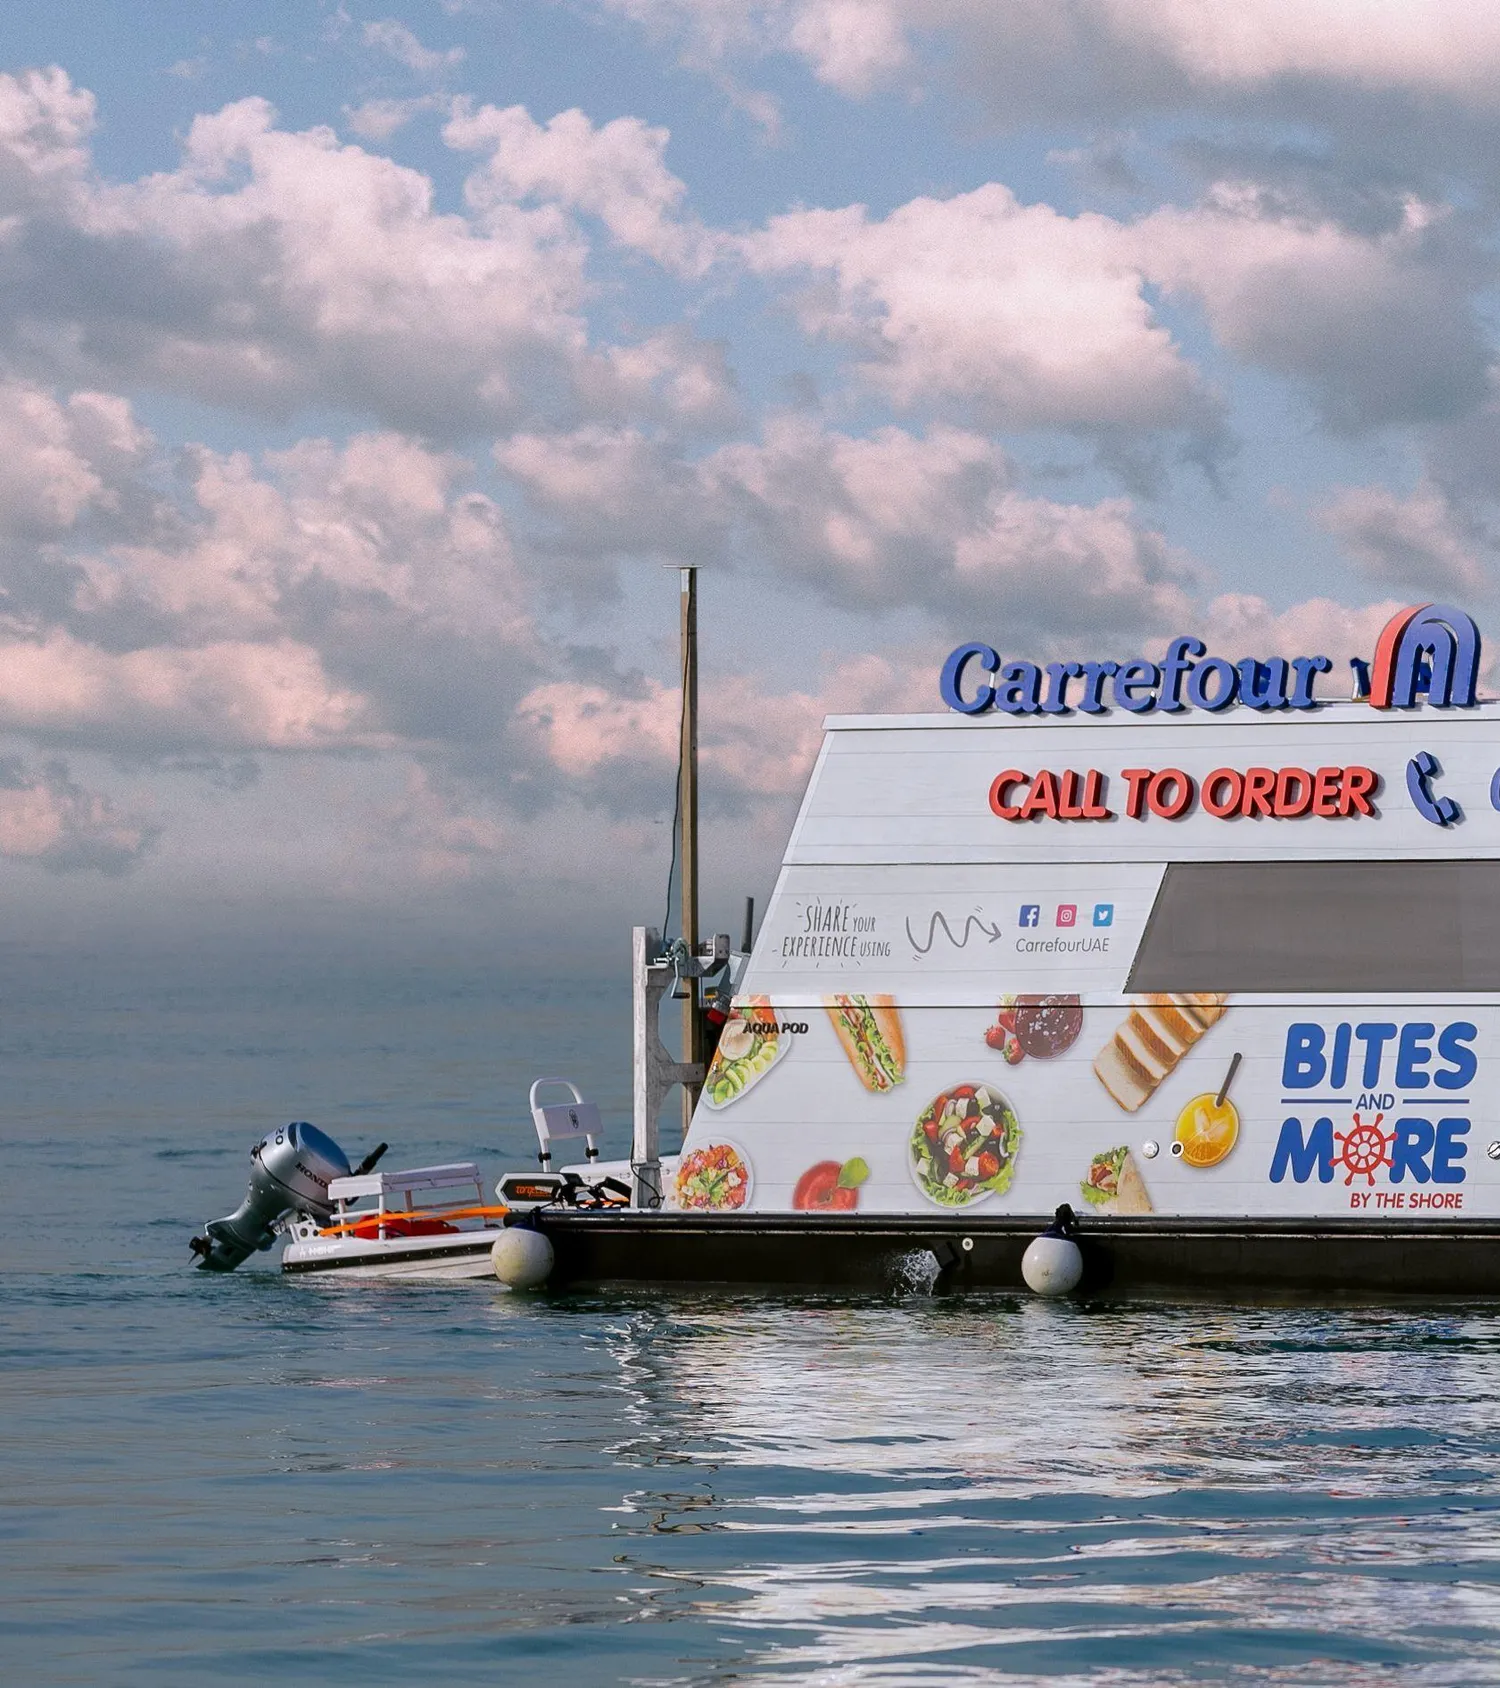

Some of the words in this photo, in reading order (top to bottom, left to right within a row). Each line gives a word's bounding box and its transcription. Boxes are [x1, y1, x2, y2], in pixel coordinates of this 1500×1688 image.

[940, 636, 1331, 715] Carrefour
[988, 769, 1112, 820] CALL
[1120, 768, 1194, 820] TO
[1201, 766, 1379, 820] ORDER
[804, 905, 850, 933] SHARE
[853, 916, 876, 932] YOUR
[782, 936, 858, 957] EXPERIENCE
[860, 941, 891, 957] USING
[1015, 937, 1110, 952] CarrefourUAE
[742, 1022, 780, 1035] AQUA
[781, 1022, 809, 1034] POD
[1281, 1021, 1478, 1090] BITES
[1355, 1093, 1396, 1110] AND
[295, 1161, 329, 1190] HOND
[1350, 1193, 1371, 1209] BY
[1375, 1193, 1405, 1209] THE
[1408, 1193, 1463, 1209] SHORE
